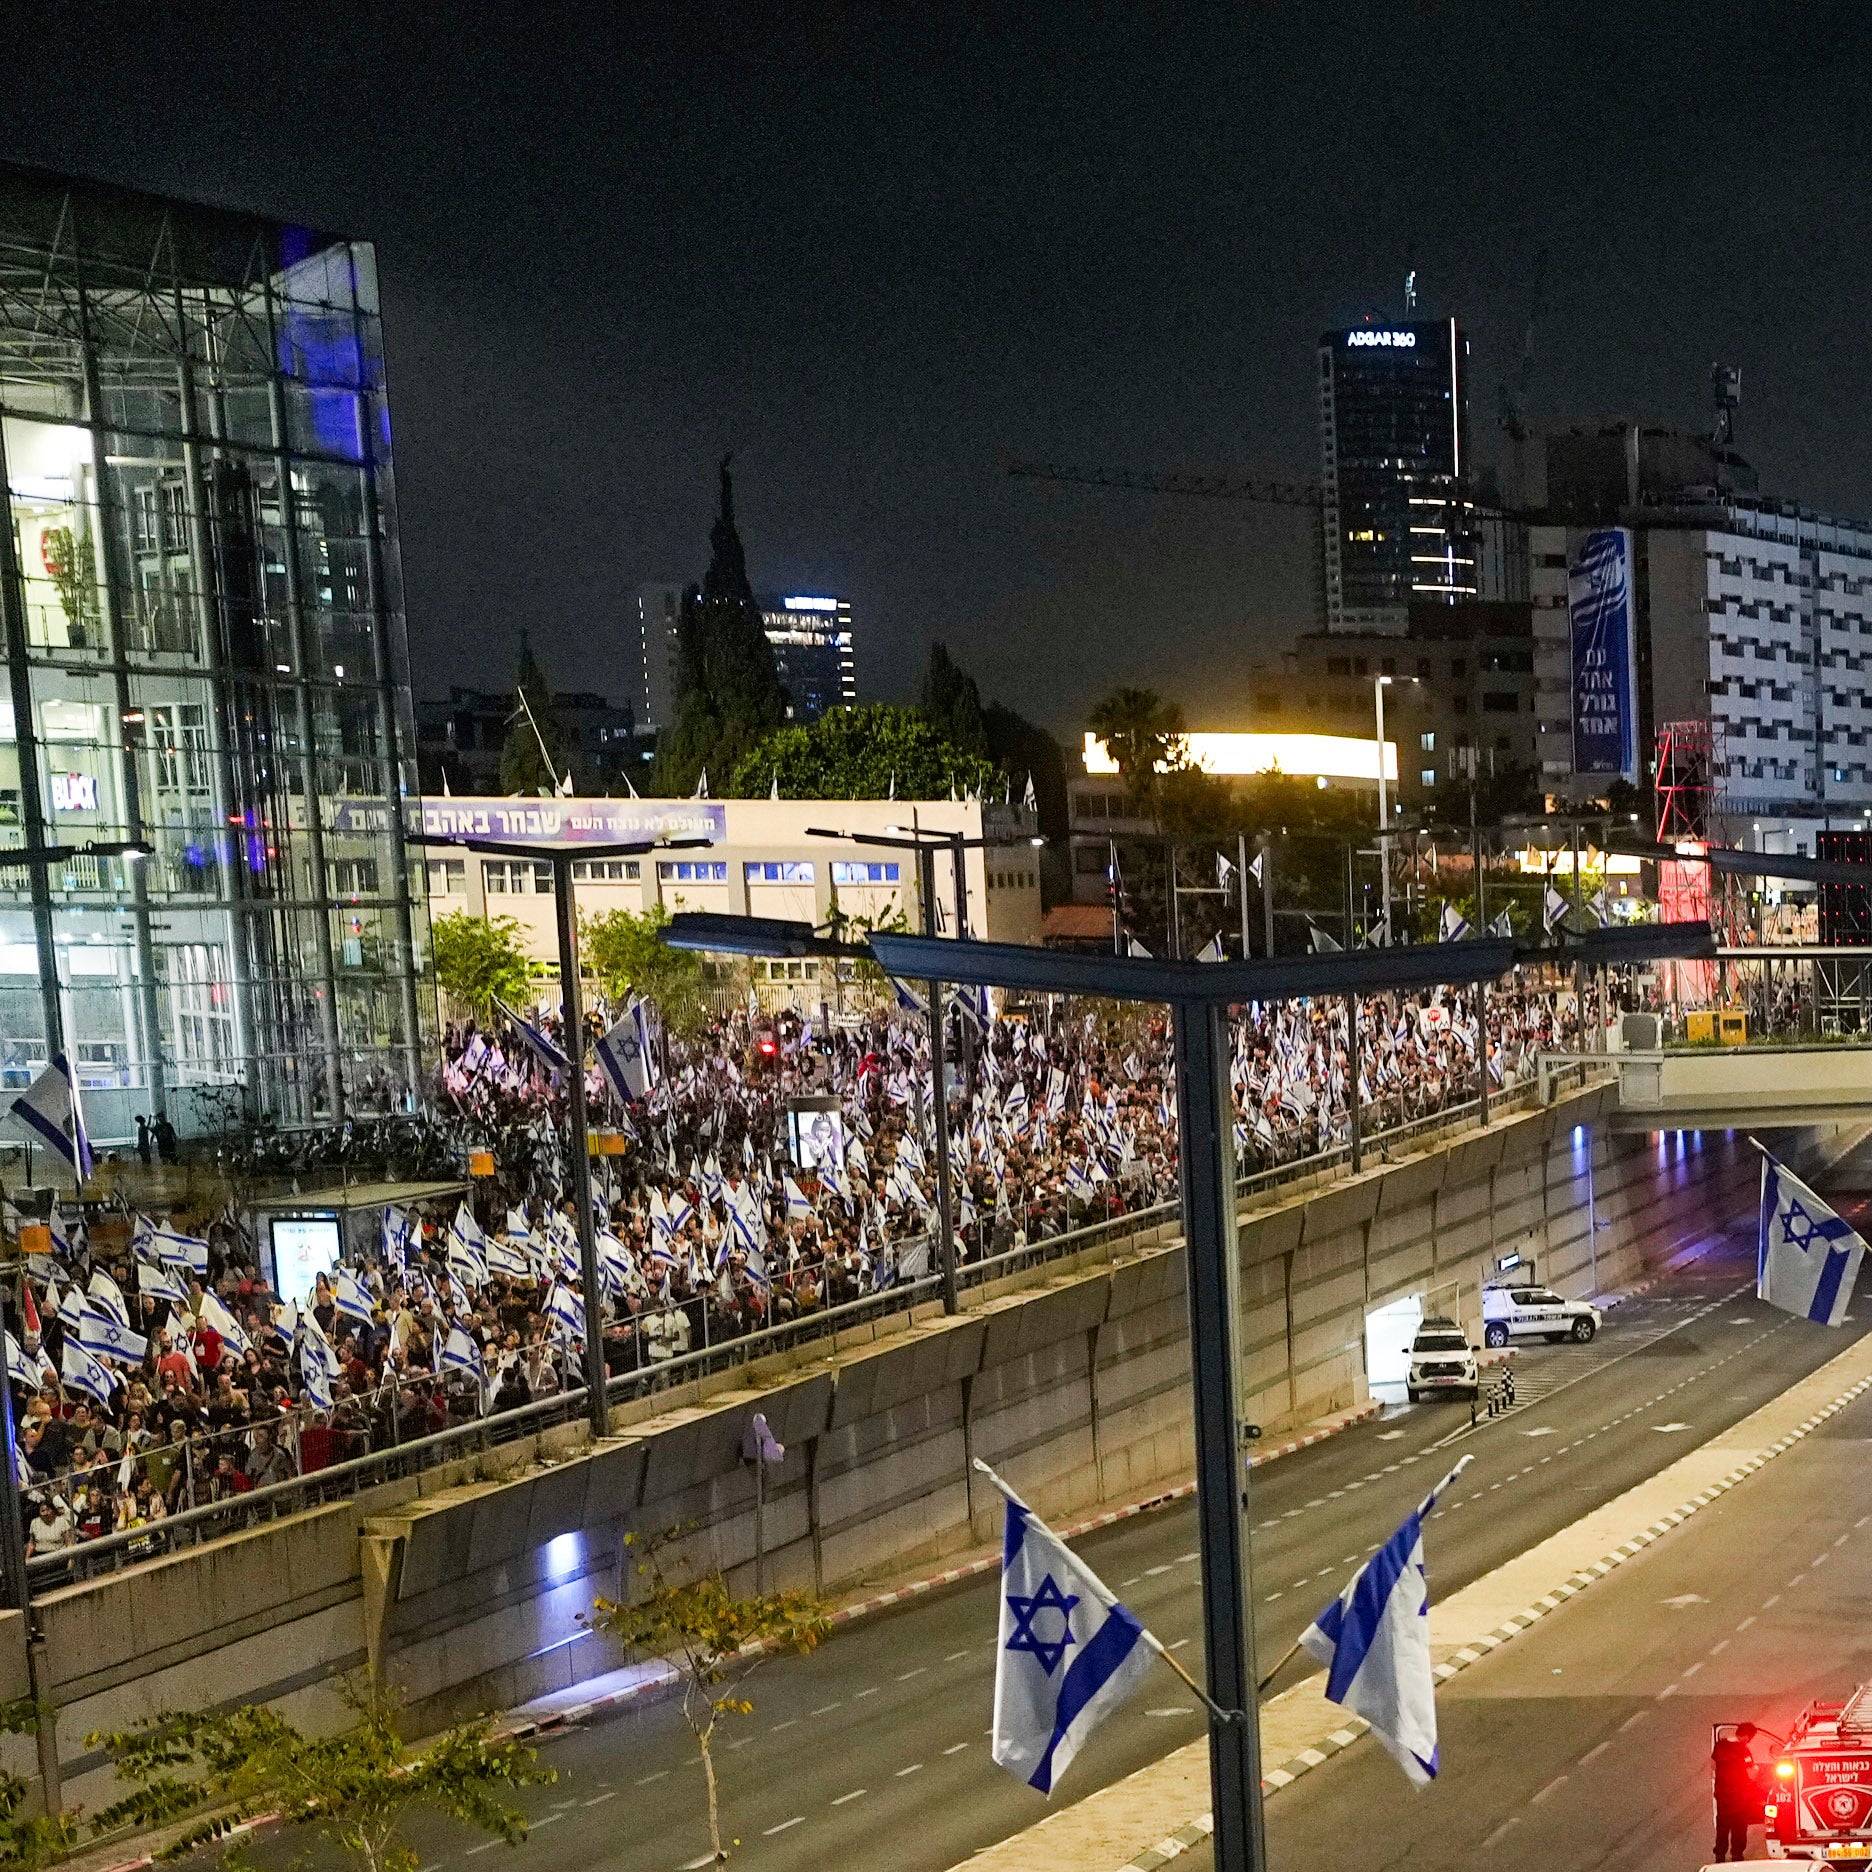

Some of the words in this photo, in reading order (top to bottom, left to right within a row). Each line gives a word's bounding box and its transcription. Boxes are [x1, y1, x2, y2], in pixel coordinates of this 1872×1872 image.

[1348, 332, 1391, 346] ADGAR
[1392, 332, 1415, 347] 360
[496, 809, 562, 835] שבחר
